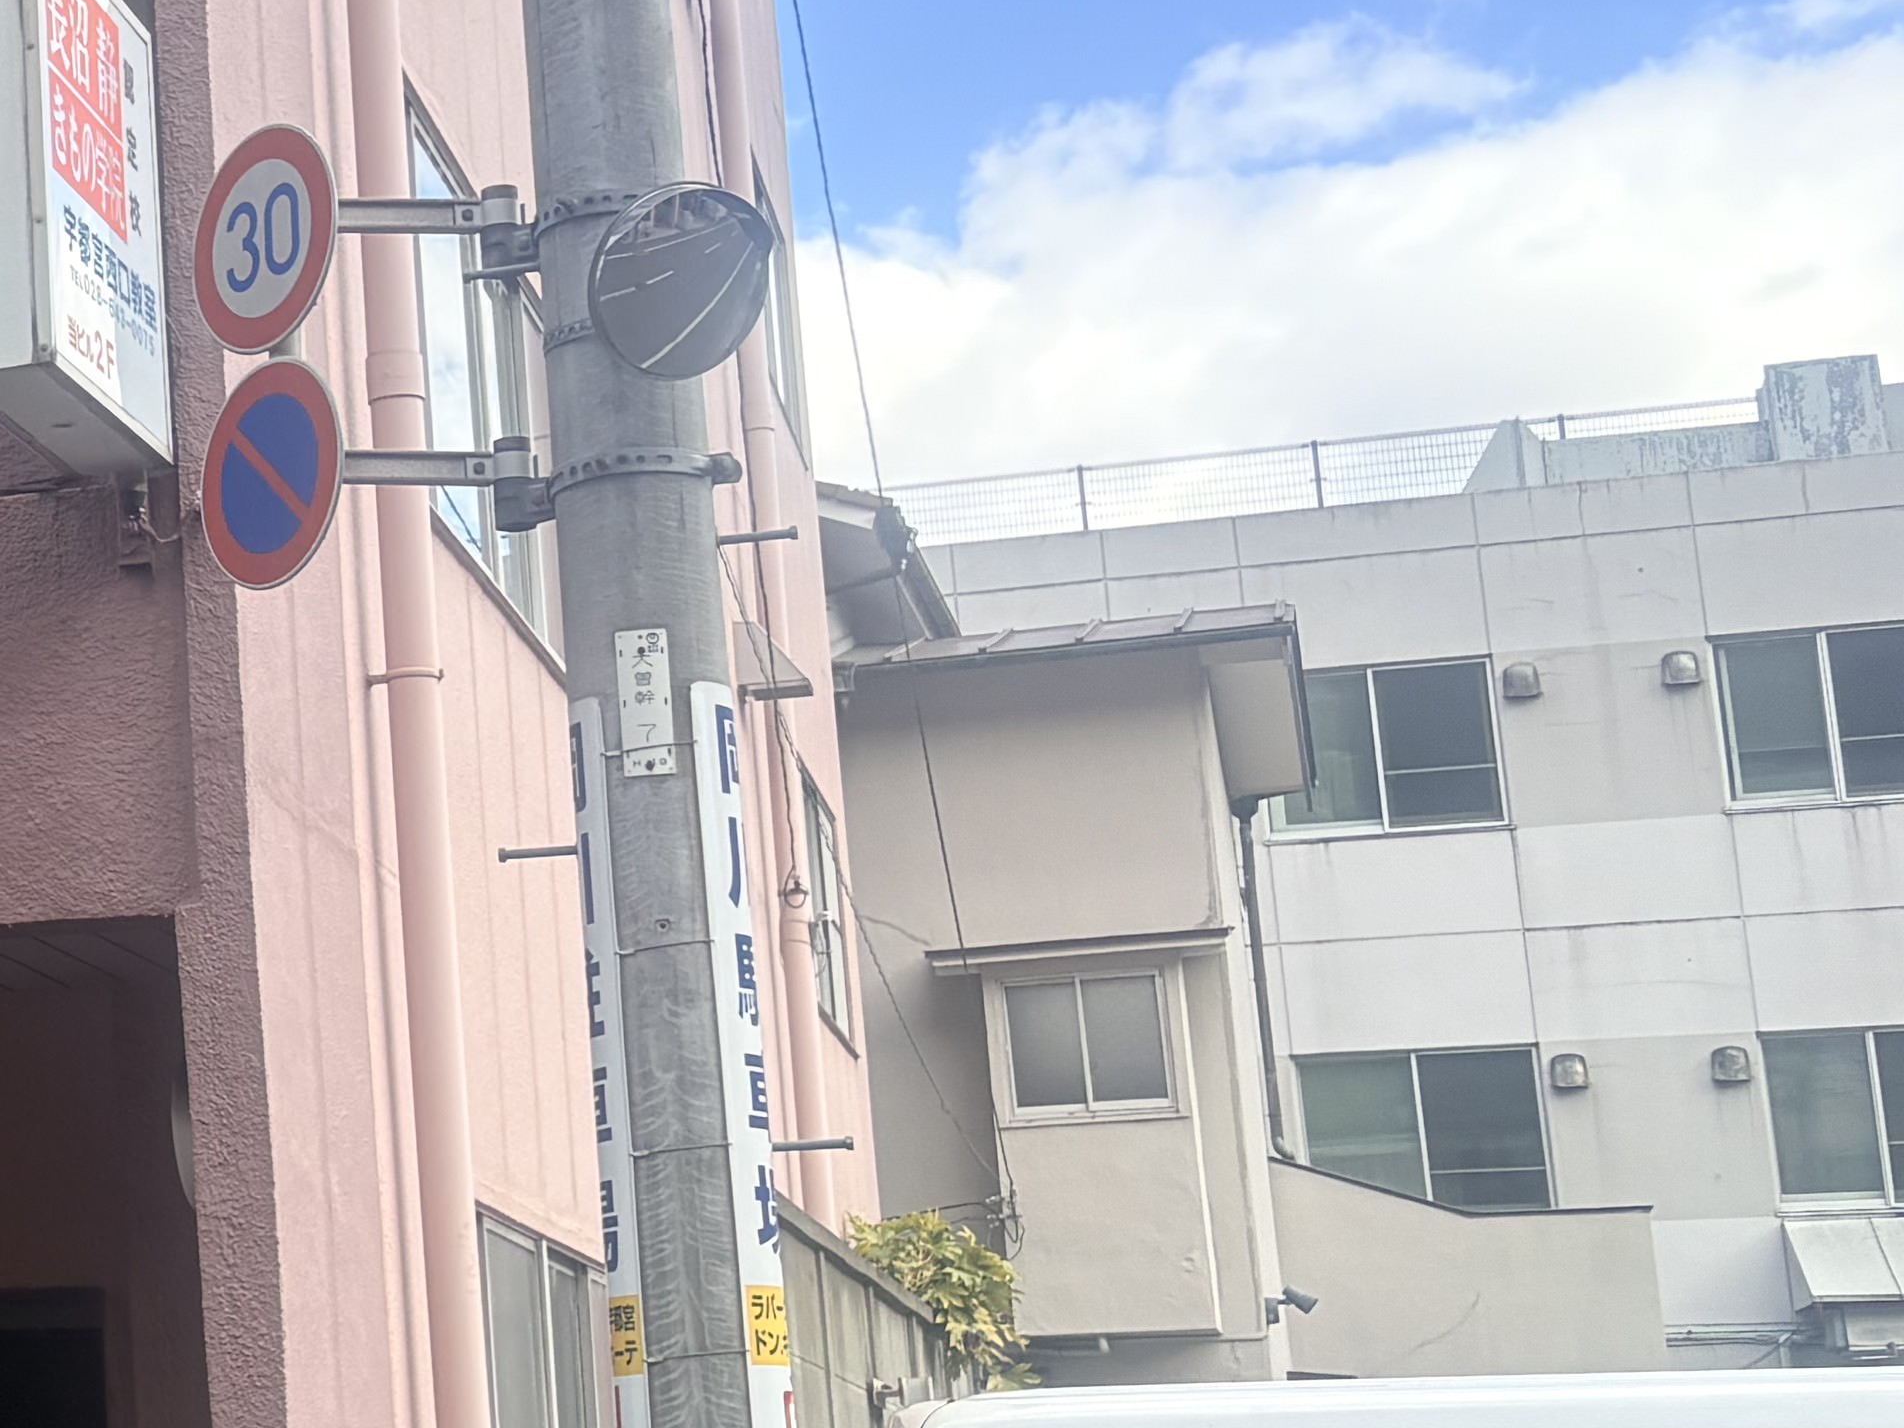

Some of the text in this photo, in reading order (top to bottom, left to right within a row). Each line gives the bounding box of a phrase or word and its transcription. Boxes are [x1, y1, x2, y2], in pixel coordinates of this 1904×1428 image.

[52, 82, 127, 234] きもの学院
[224, 181, 301, 295] 30
